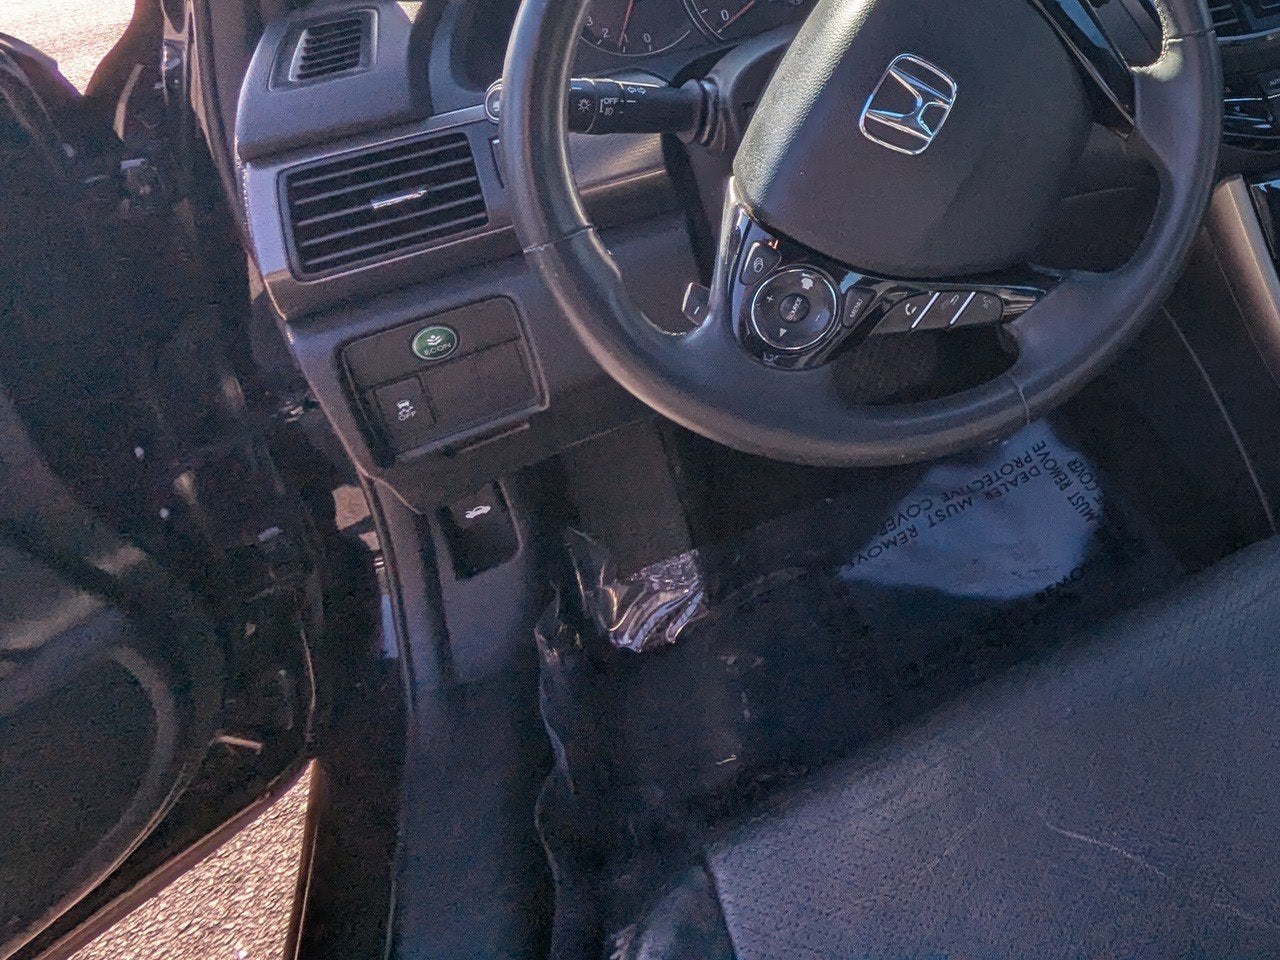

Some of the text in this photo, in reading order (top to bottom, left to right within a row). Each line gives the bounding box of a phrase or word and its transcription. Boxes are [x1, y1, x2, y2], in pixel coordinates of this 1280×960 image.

[586, 16, 594, 26] 3
[721, 9, 730, 21] 0
[602, 27, 610, 38] 2
[643, 33, 651, 43] 0
[424, 343, 451, 356] ECON
[398, 410, 416, 421] OFF
[1067, 457, 1098, 491] COVER
[984, 465, 1041, 501] DEALER
[1032, 440, 1096, 523] MUST REMOVE
[927, 496, 973, 528] MUST
